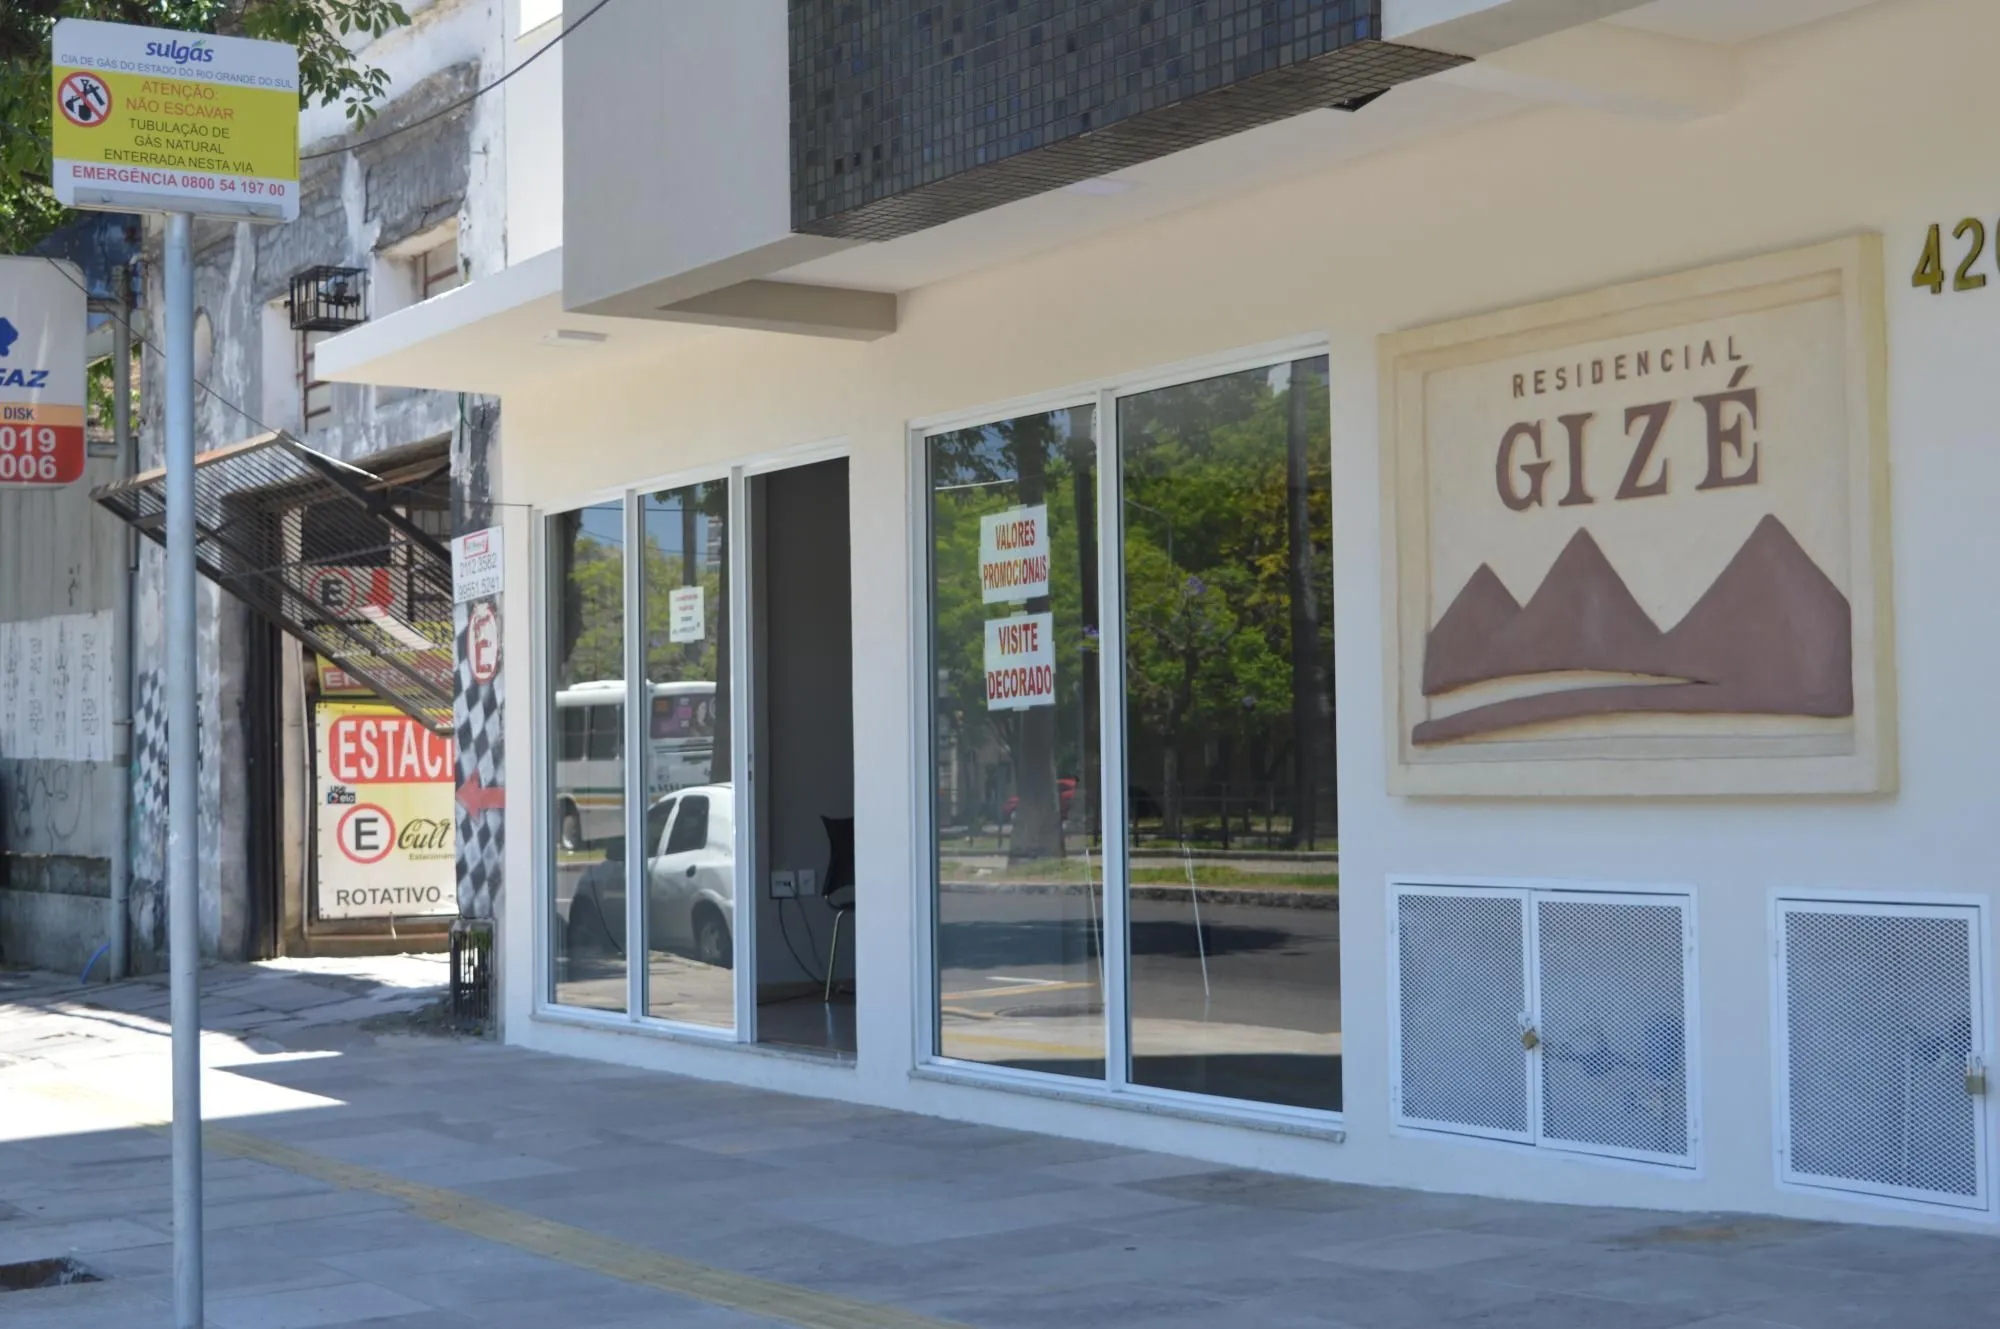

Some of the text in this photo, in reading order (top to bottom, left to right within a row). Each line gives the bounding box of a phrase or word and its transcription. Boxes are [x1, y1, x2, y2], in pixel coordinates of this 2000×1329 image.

[146, 39, 214, 64] sulgás
[61, 53, 78, 65] CIA
[80, 56, 95, 66] DE
[120, 60, 135, 71] DO
[138, 63, 177, 76] ESTADO
[179, 67, 194, 78] DO
[196, 68, 213, 80] RIO
[215, 71, 256, 85] GRANDE
[258, 75, 273, 86] DO
[274, 78, 293, 89] SUL
[141, 79, 219, 101] ATENÇÃO:
[126, 96, 235, 121] NÃO ESCAVAR
[129, 118, 230, 139] TUBULAÇÃO DE
[134, 134, 225, 155] GÁS NATURAL
[104, 148, 254, 173] ENTERRADA NESTA VIA
[72, 165, 285, 197] EMERGÊNCIA 0800 54 197 00
[1911, 217, 2000, 295] 42
[1512, 336, 1744, 399] RESIDENCIAL
[4, 406, 34, 420] DISK
[0, 426, 56, 453] 019
[1496, 364, 1761, 513] GIZÉ
[0, 453, 57, 479] 006
[996, 519, 1036, 551] VALORES
[983, 555, 1047, 590] PROMOCIONAIS
[998, 622, 1038, 655] VISITE
[987, 664, 1053, 700] DECORADO
[355, 817, 380, 851] E
[336, 886, 441, 906] ROTATIVO
